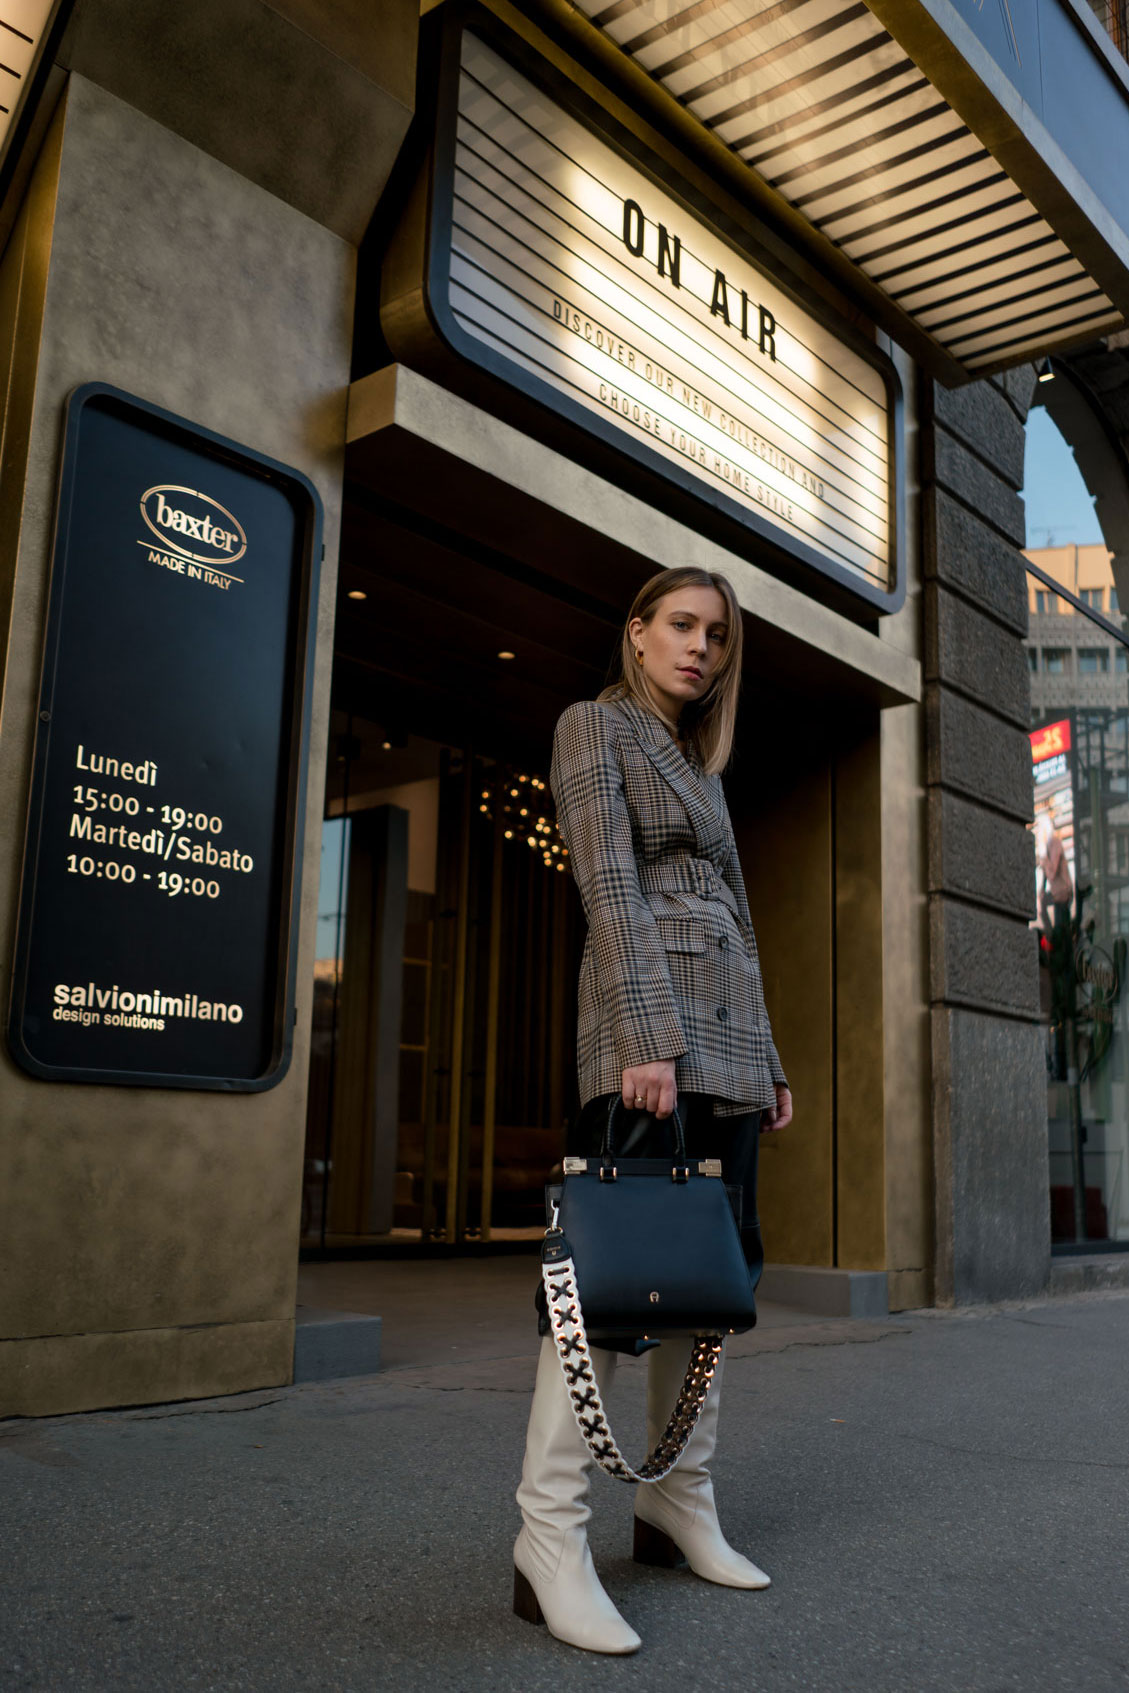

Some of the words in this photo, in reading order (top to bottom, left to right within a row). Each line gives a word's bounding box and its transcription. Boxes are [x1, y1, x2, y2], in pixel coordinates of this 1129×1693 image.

[623, 199, 681, 289] ON
[710, 268, 776, 362] AIR
[553, 299, 636, 369] DISCOVER
[645, 363, 674, 393] OUR
[682, 387, 712, 419] NEW
[720, 413, 795, 481] COLLECTION
[801, 472, 825, 500] AND
[599, 383, 660, 436] CHOOSE
[670, 427, 706, 464] YOUR
[714, 456, 750, 493] HOME
[756, 485, 793, 521] STYLE
[155, 493, 239, 553] baxter
[148, 551, 186, 574] MADE
[187, 564, 202, 580] IN
[204, 571, 232, 590] ITALY
[76, 744, 158, 786] Lunedì
[73, 785, 140, 816] 15:00
[161, 805, 223, 834] 19:00
[69, 813, 254, 873] Martedì/Sabato
[67, 854, 136, 883] 10:00
[158, 871, 220, 898] 19:00
[52, 1006, 100, 1027] design
[103, 1012, 166, 1031] solutions
[53, 982, 243, 1024] salvionimilano
